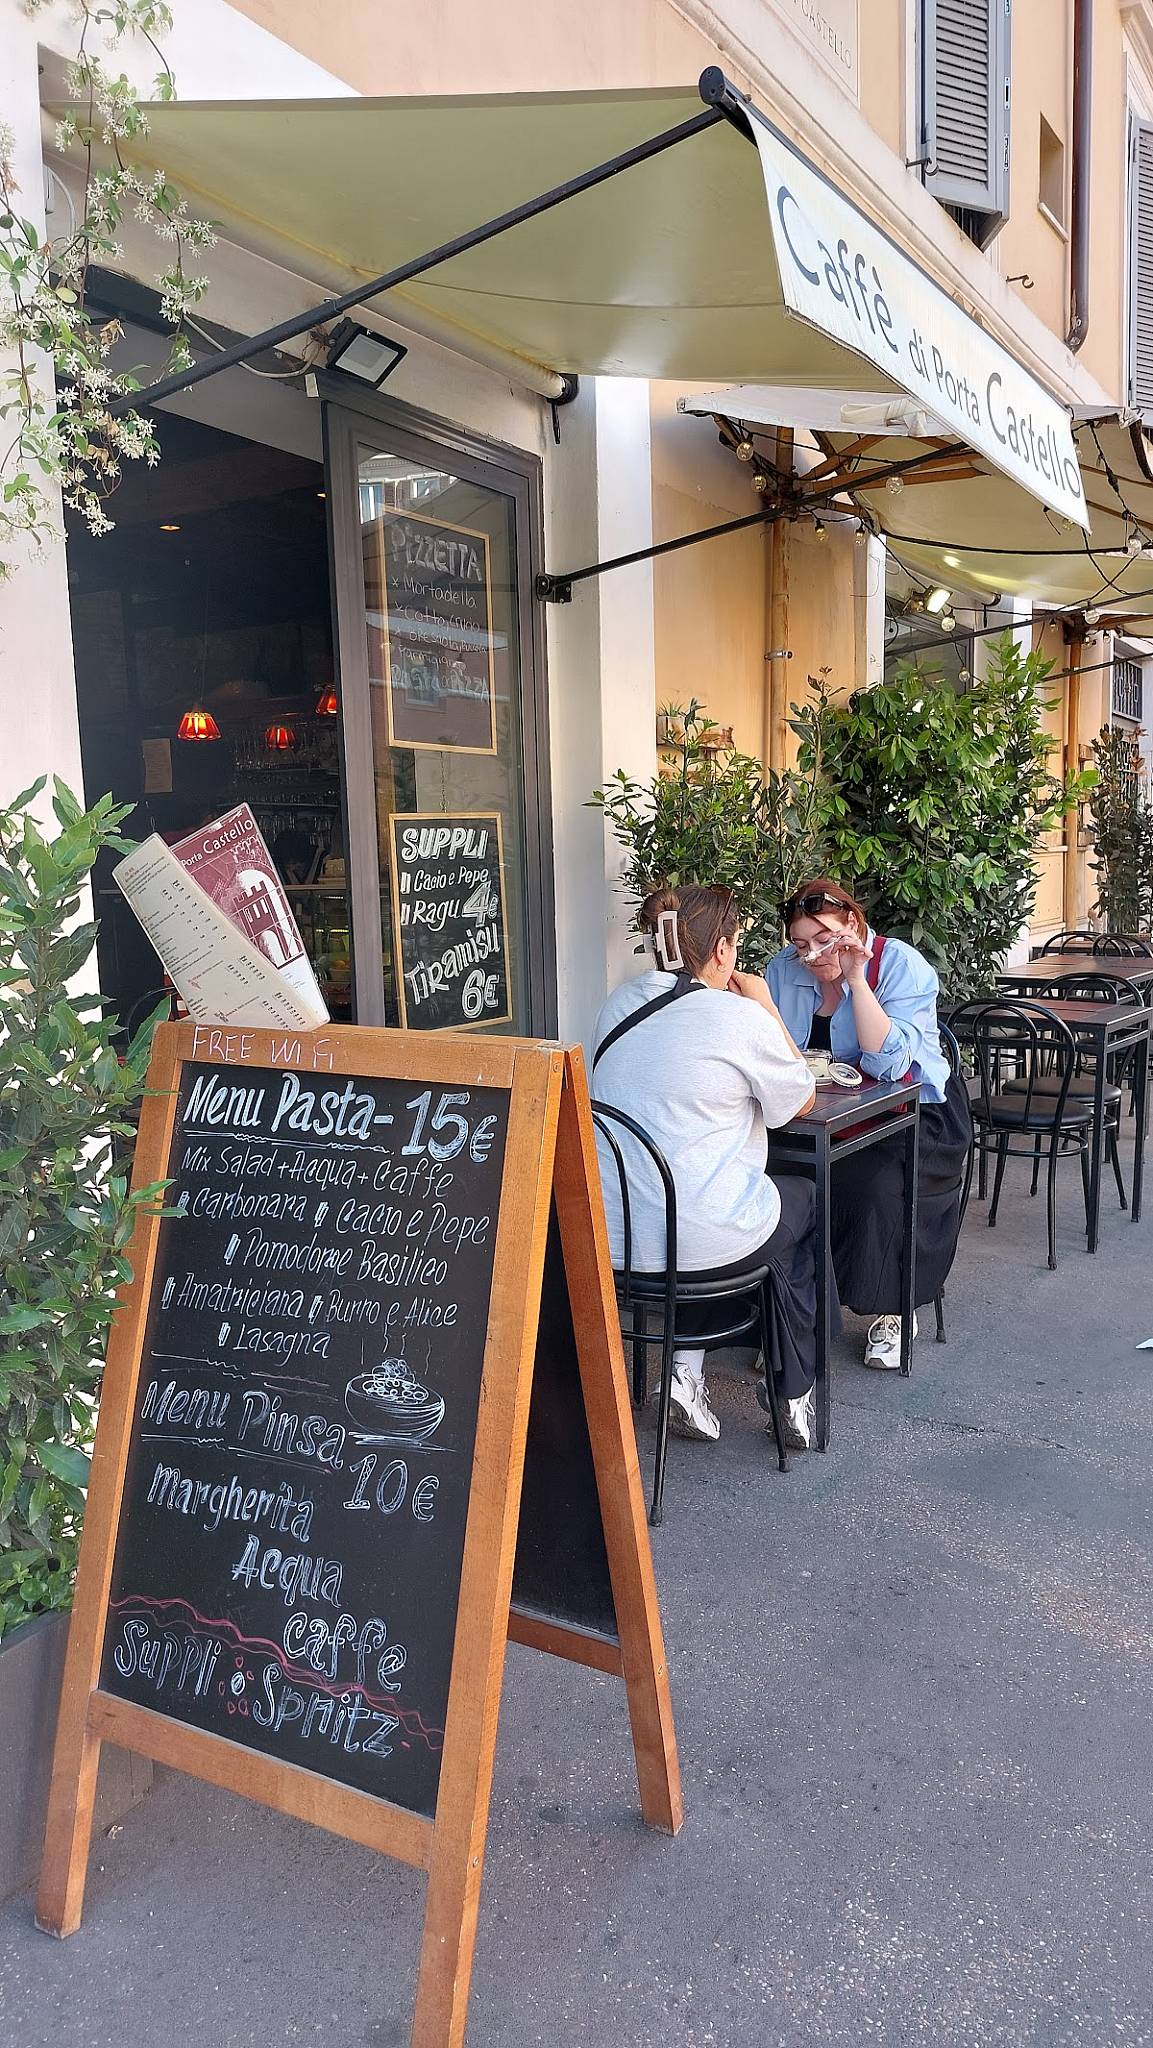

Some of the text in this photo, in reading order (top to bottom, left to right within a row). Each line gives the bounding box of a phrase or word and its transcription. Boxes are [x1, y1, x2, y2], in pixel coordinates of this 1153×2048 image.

[776, 185, 1081, 498] Caffè di Porta Castello
[403, 573, 477, 608] Mortadella
[180, 818, 254, 870] Porta Castello
[401, 826, 489, 864] SUPPLI
[413, 865, 489, 892] Cacio e Pepe
[406, 899, 460, 931] Ragu
[192, 1026, 256, 1063] FREE
[183, 1074, 266, 1127] Menu
[180, 1147, 212, 1173] Mix
[215, 1145, 278, 1178] Salad
[373, 1157, 454, 1200] Caffe
[192, 1183, 308, 1222] Carbonara
[406, 1210, 424, 1237] e
[424, 1202, 490, 1254] Pepe
[357, 1239, 448, 1286] Basilico
[176, 1272, 458, 1328] Amatriciana Burro e Alice
[232, 1323, 331, 1367] Lasagna
[140, 1380, 231, 1428] Menu
[237, 1390, 346, 1470] Pinsa
[230, 1533, 343, 1608] Acqua
[114, 1618, 222, 1697] Suppli
[252, 1662, 400, 1759] Spritz
